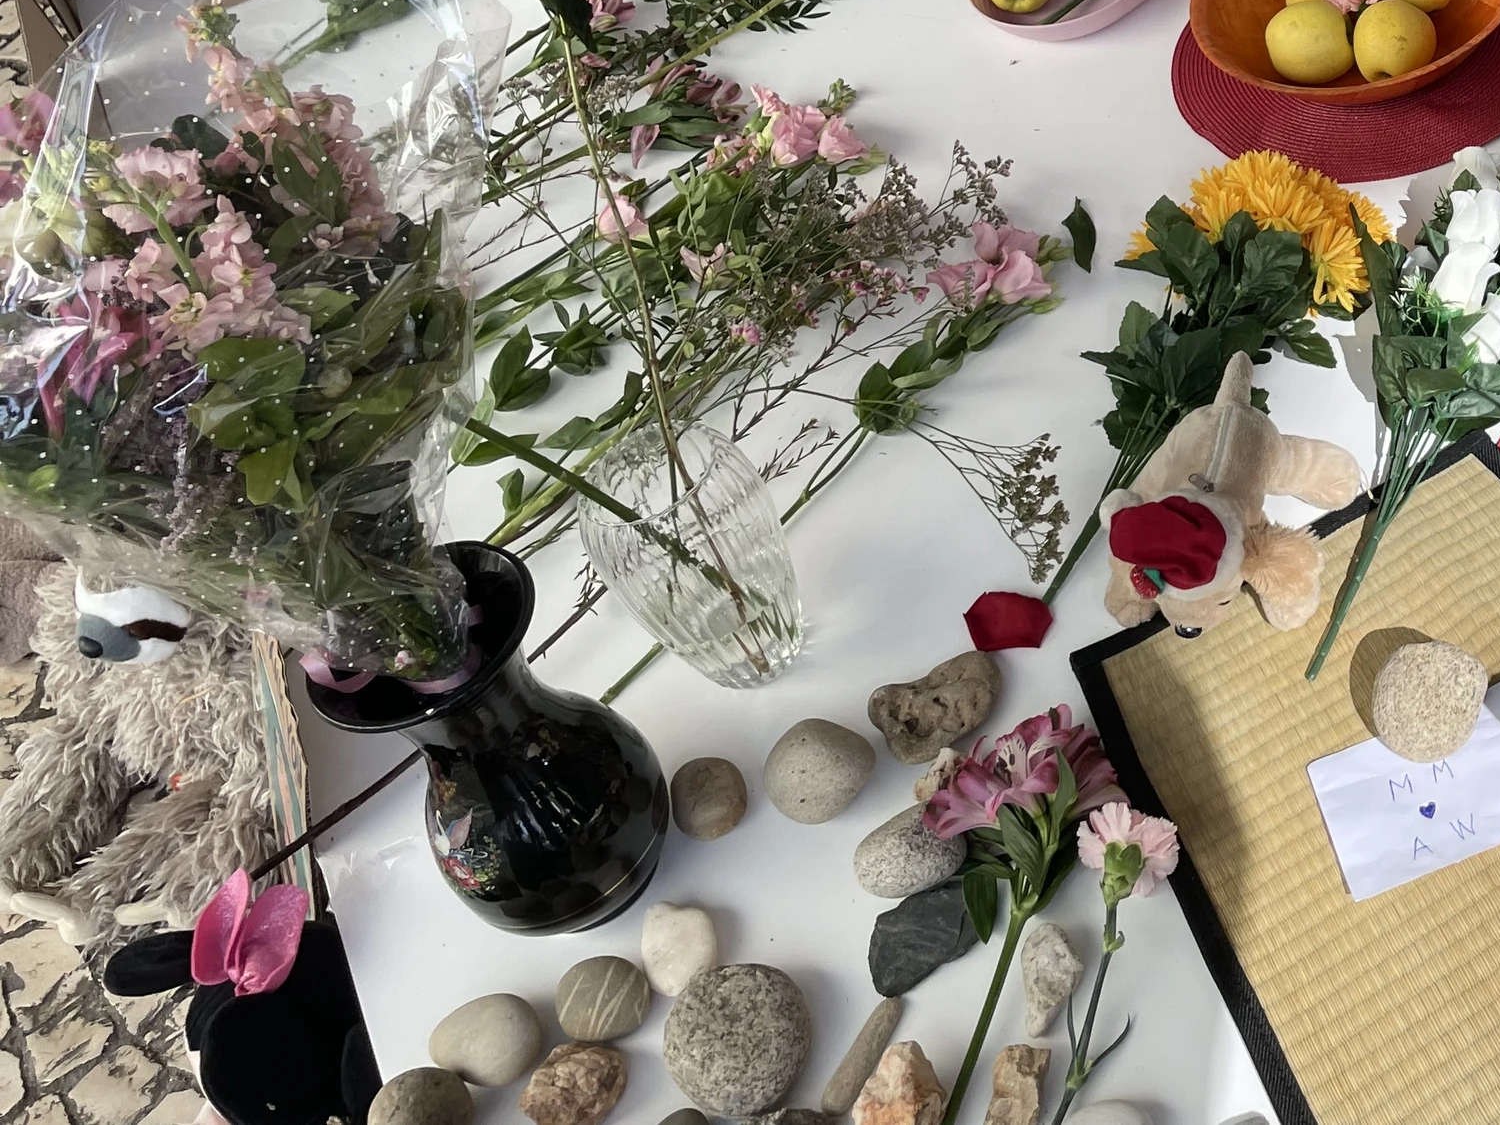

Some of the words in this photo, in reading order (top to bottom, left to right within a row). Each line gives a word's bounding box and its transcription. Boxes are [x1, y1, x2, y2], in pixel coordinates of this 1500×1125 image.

[1389, 773, 1413, 802] M
[1432, 758, 1454, 783] M
[1413, 836, 1434, 861] A
[1449, 813, 1475, 841] W
